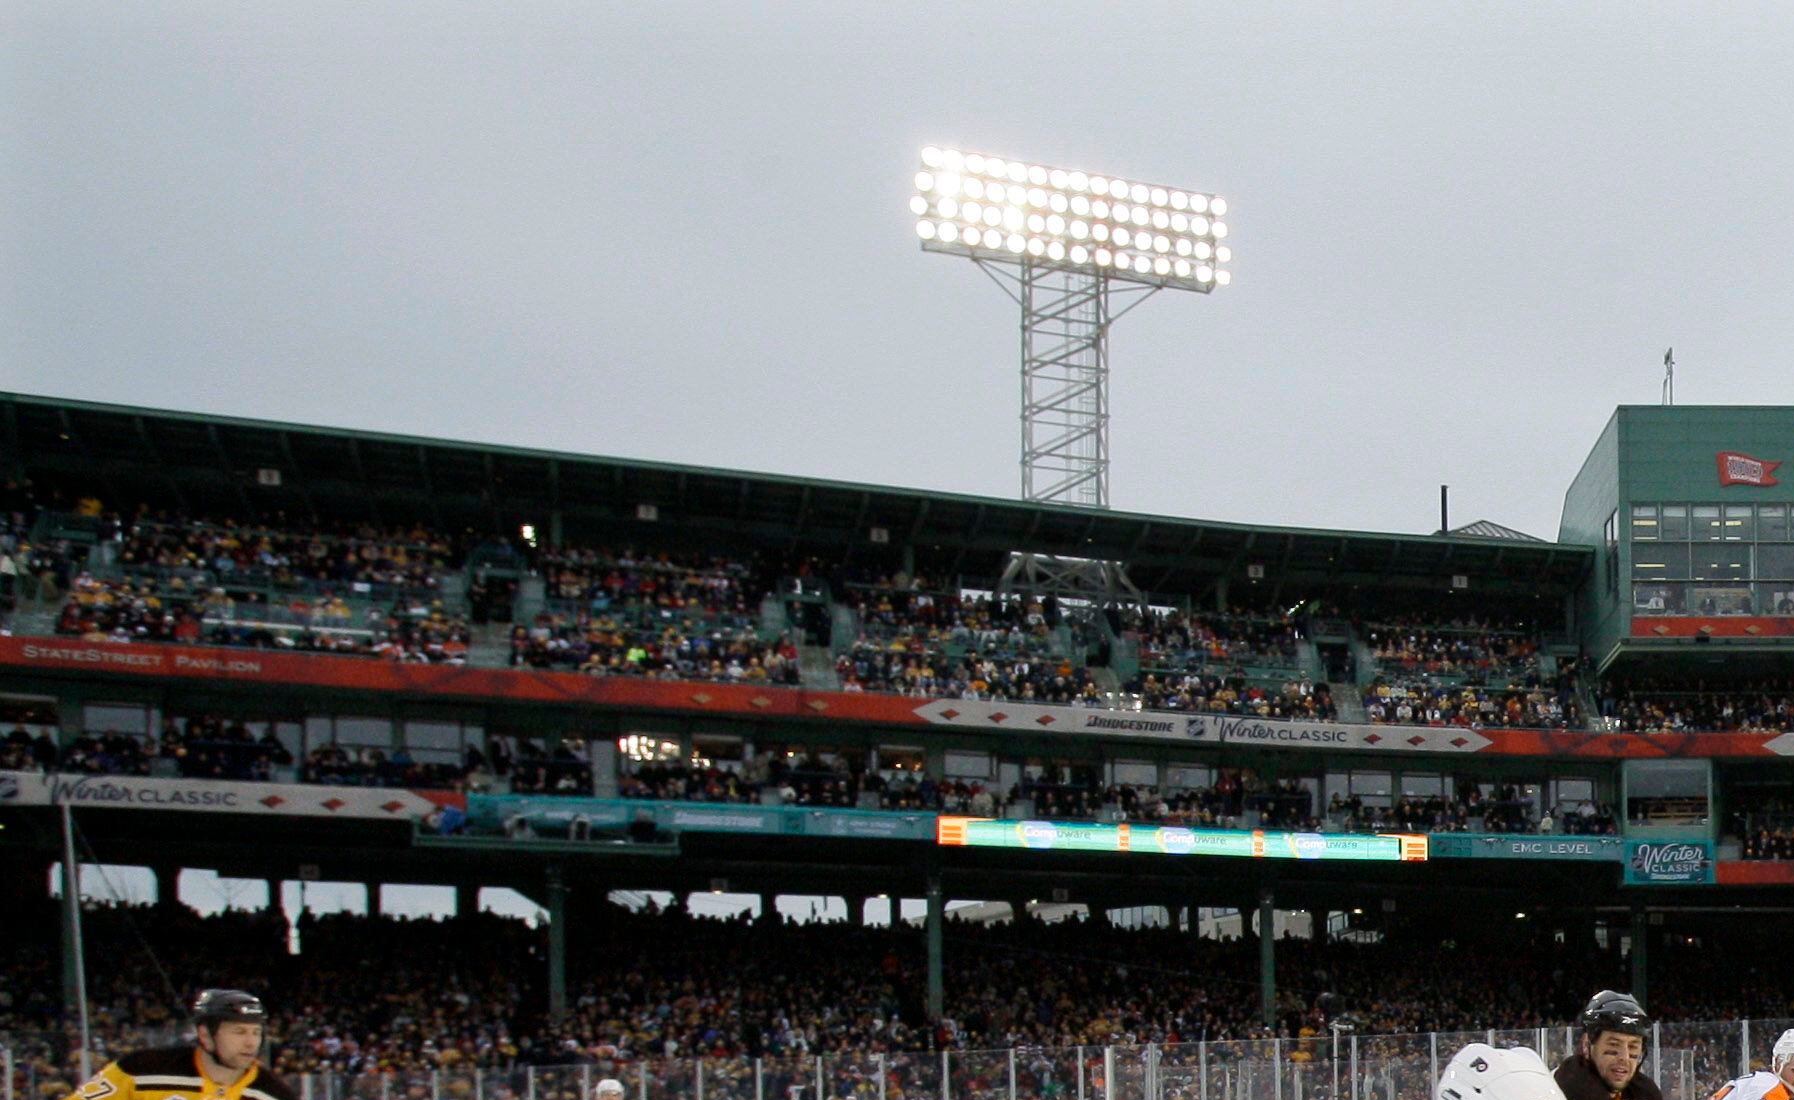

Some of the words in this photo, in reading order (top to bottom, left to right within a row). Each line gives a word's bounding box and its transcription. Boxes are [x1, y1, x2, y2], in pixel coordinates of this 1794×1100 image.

[1087, 714, 1174, 733] BRIDGESTONE
[1214, 716, 1278, 742] Winter
[1278, 728, 1347, 743] CLASSIC
[44, 774, 134, 803] Winter
[138, 788, 238, 806] CLASSIC
[1163, 831, 1226, 846] Compuware
[1512, 843, 1541, 853] EMC
[1550, 843, 1593, 854] LEVEL
[1638, 843, 1704, 873] Winter
[1652, 864, 1700, 873] CLASSIC
